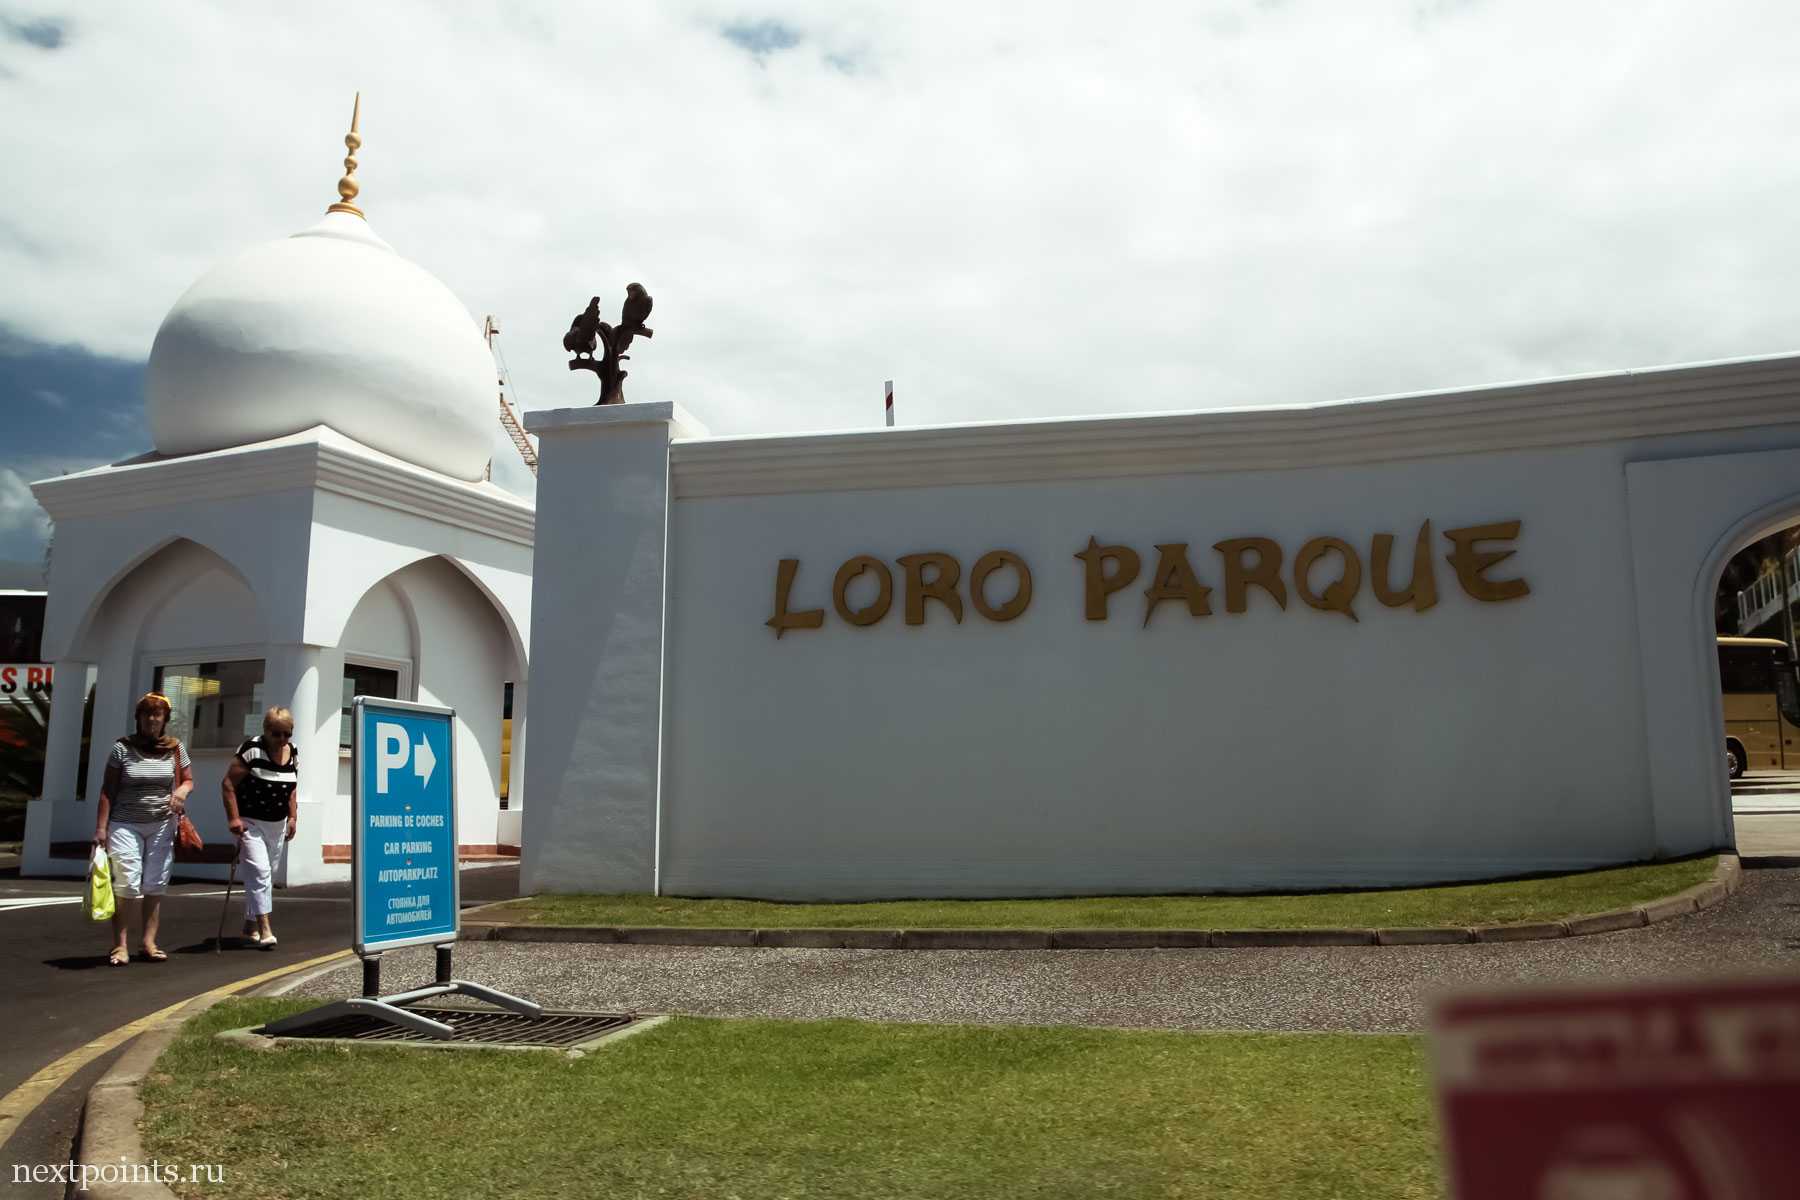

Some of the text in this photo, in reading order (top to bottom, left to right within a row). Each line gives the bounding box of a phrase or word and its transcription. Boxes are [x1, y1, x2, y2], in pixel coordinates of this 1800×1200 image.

[764, 517, 1531, 640] LORO PARQUE
[376, 721, 411, 794] P
[370, 815, 444, 828] PARKING DE COCHES
[384, 841, 433, 855] CAR PARKING
[378, 867, 439, 883] AUTOPARKPLATZ
